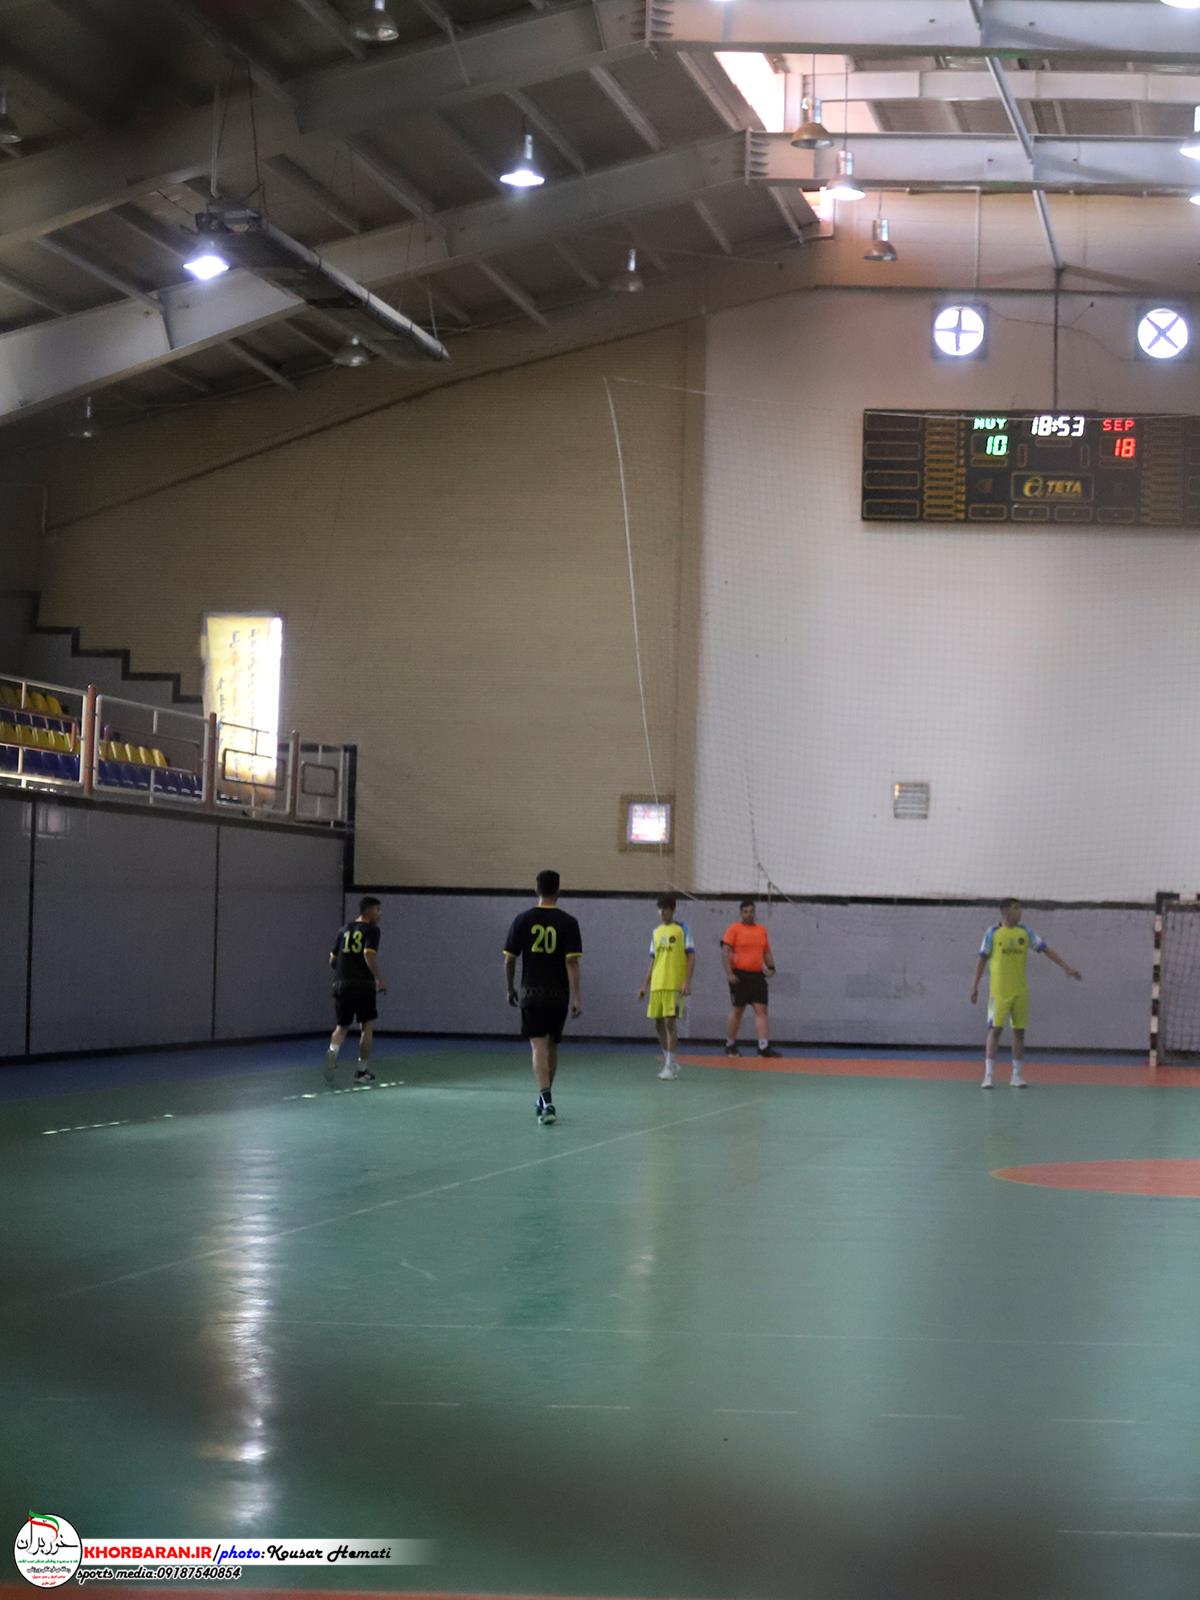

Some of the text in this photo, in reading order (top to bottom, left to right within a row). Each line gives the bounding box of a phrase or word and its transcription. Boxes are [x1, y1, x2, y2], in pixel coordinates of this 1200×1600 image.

[1031, 416, 1085, 437] 18:53
[1102, 418, 1135, 431] SEP
[986, 435, 1009, 456] 10
[1115, 437, 1136, 458] 18
[1045, 479, 1082, 494] TETA
[342, 930, 363, 954] 13
[530, 924, 557, 954] 20
